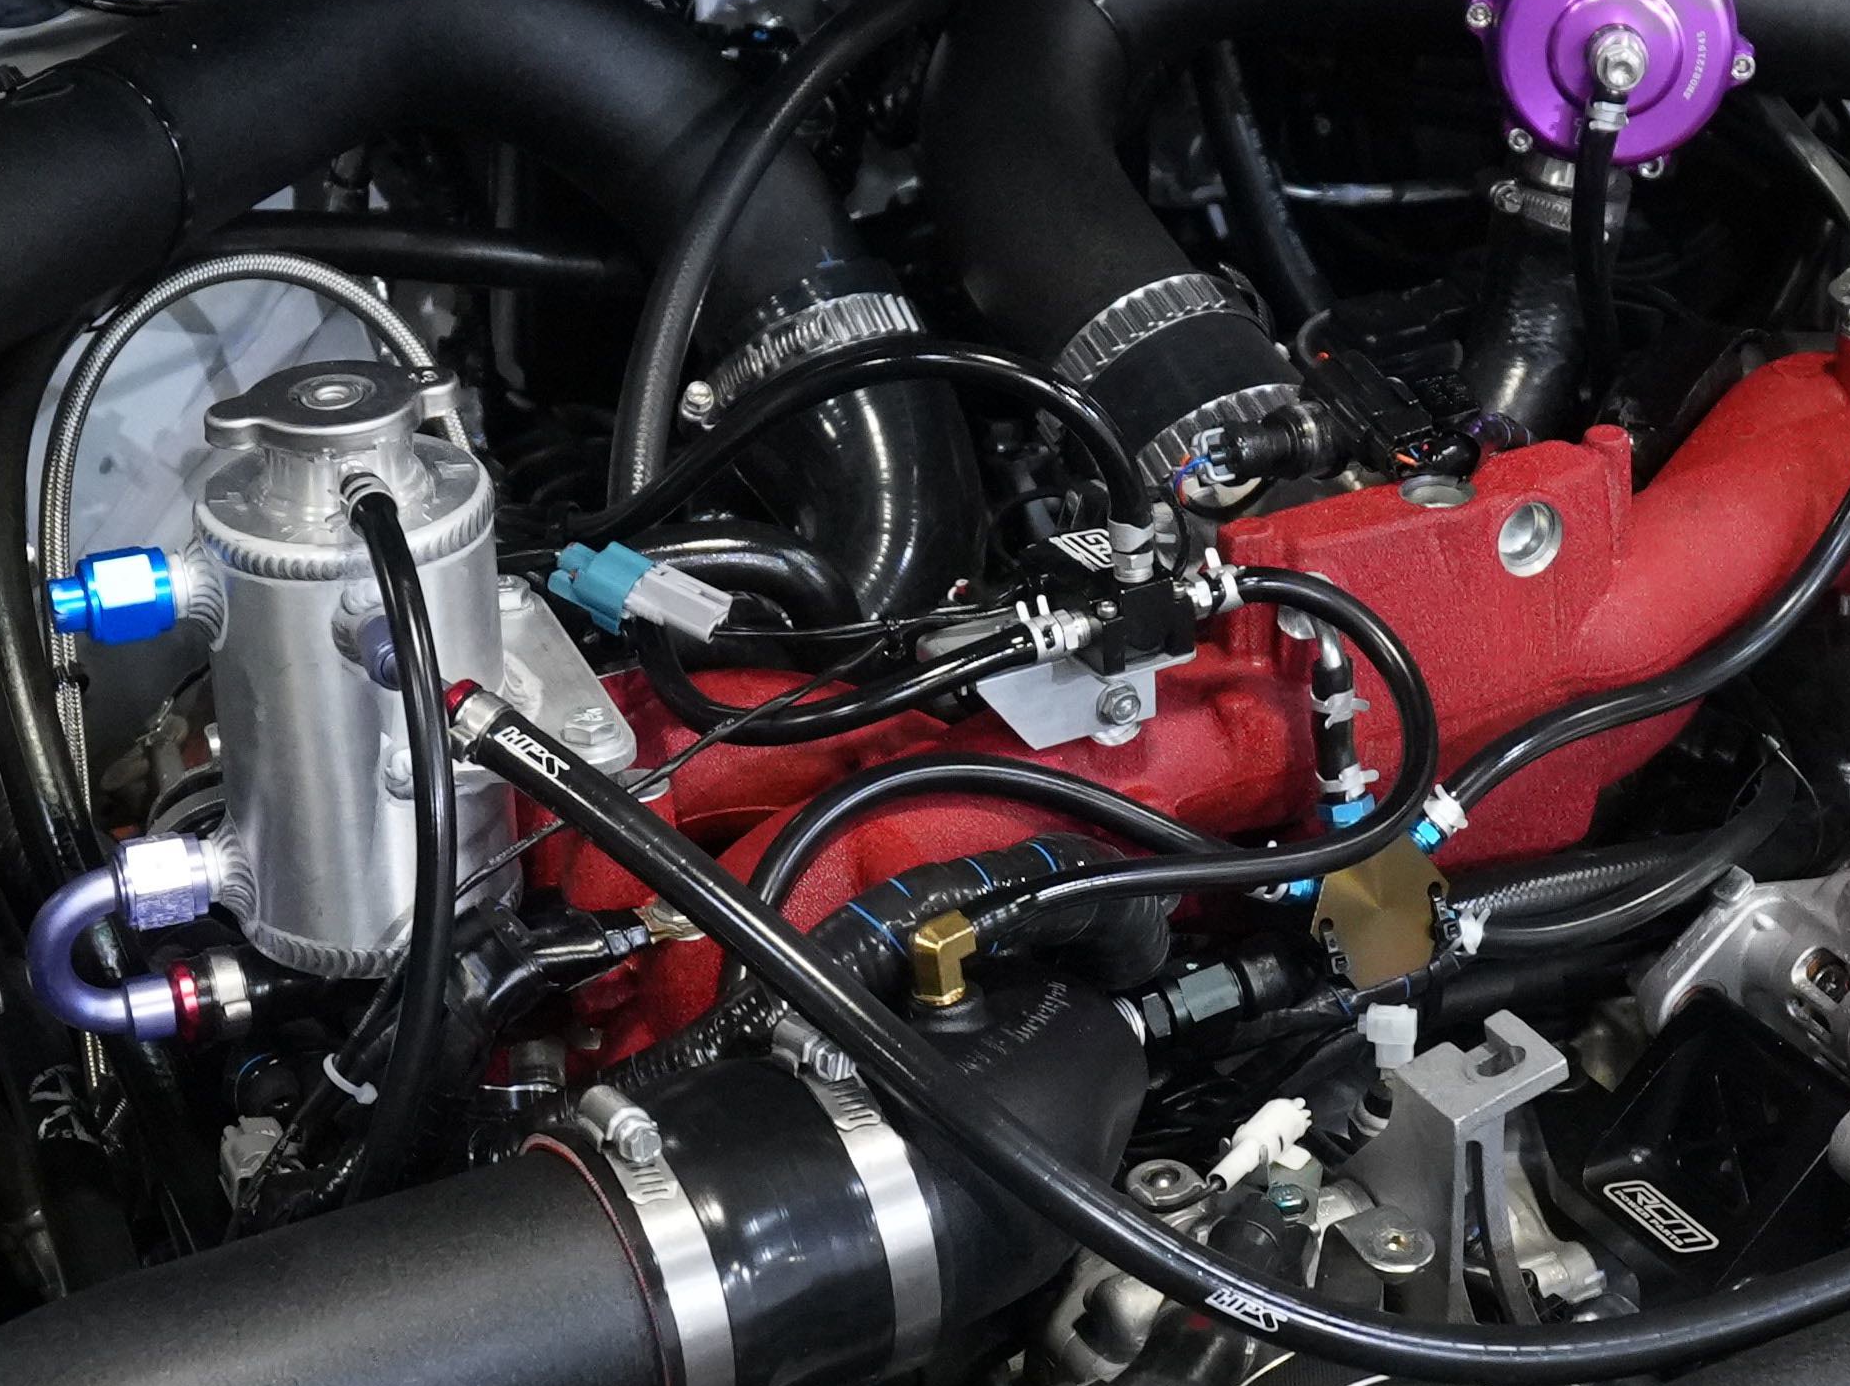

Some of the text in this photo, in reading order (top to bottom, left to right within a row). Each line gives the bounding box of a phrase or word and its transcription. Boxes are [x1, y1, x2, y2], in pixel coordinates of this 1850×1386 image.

[494, 725, 570, 779] HPS
[1613, 1189, 1685, 1247] POWER PARTS
[1621, 1186, 1709, 1243] RCM
[1204, 1287, 1288, 1332] HPS
